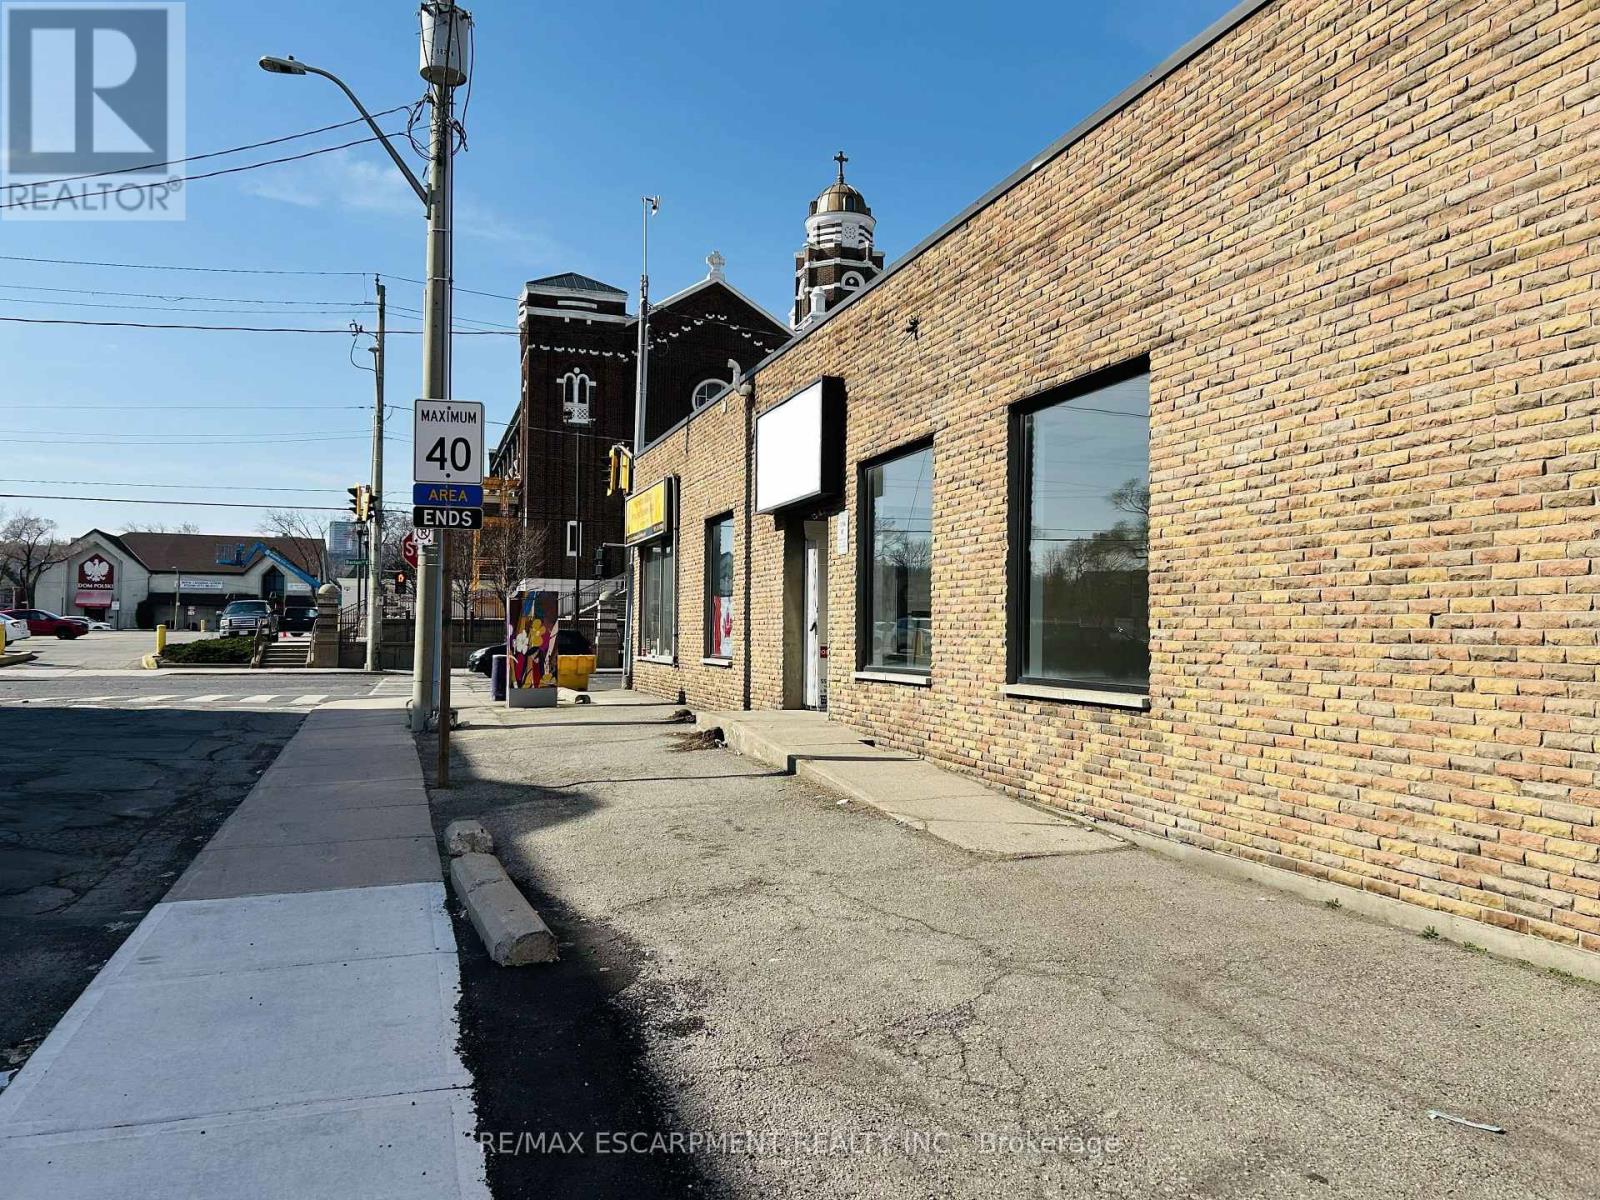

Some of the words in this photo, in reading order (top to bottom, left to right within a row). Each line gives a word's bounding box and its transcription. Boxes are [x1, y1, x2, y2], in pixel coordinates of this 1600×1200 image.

[421, 409, 477, 424] MAXIMUM
[425, 436, 472, 472] 40
[428, 488, 468, 503] AREA
[423, 509, 472, 527] ENDS
